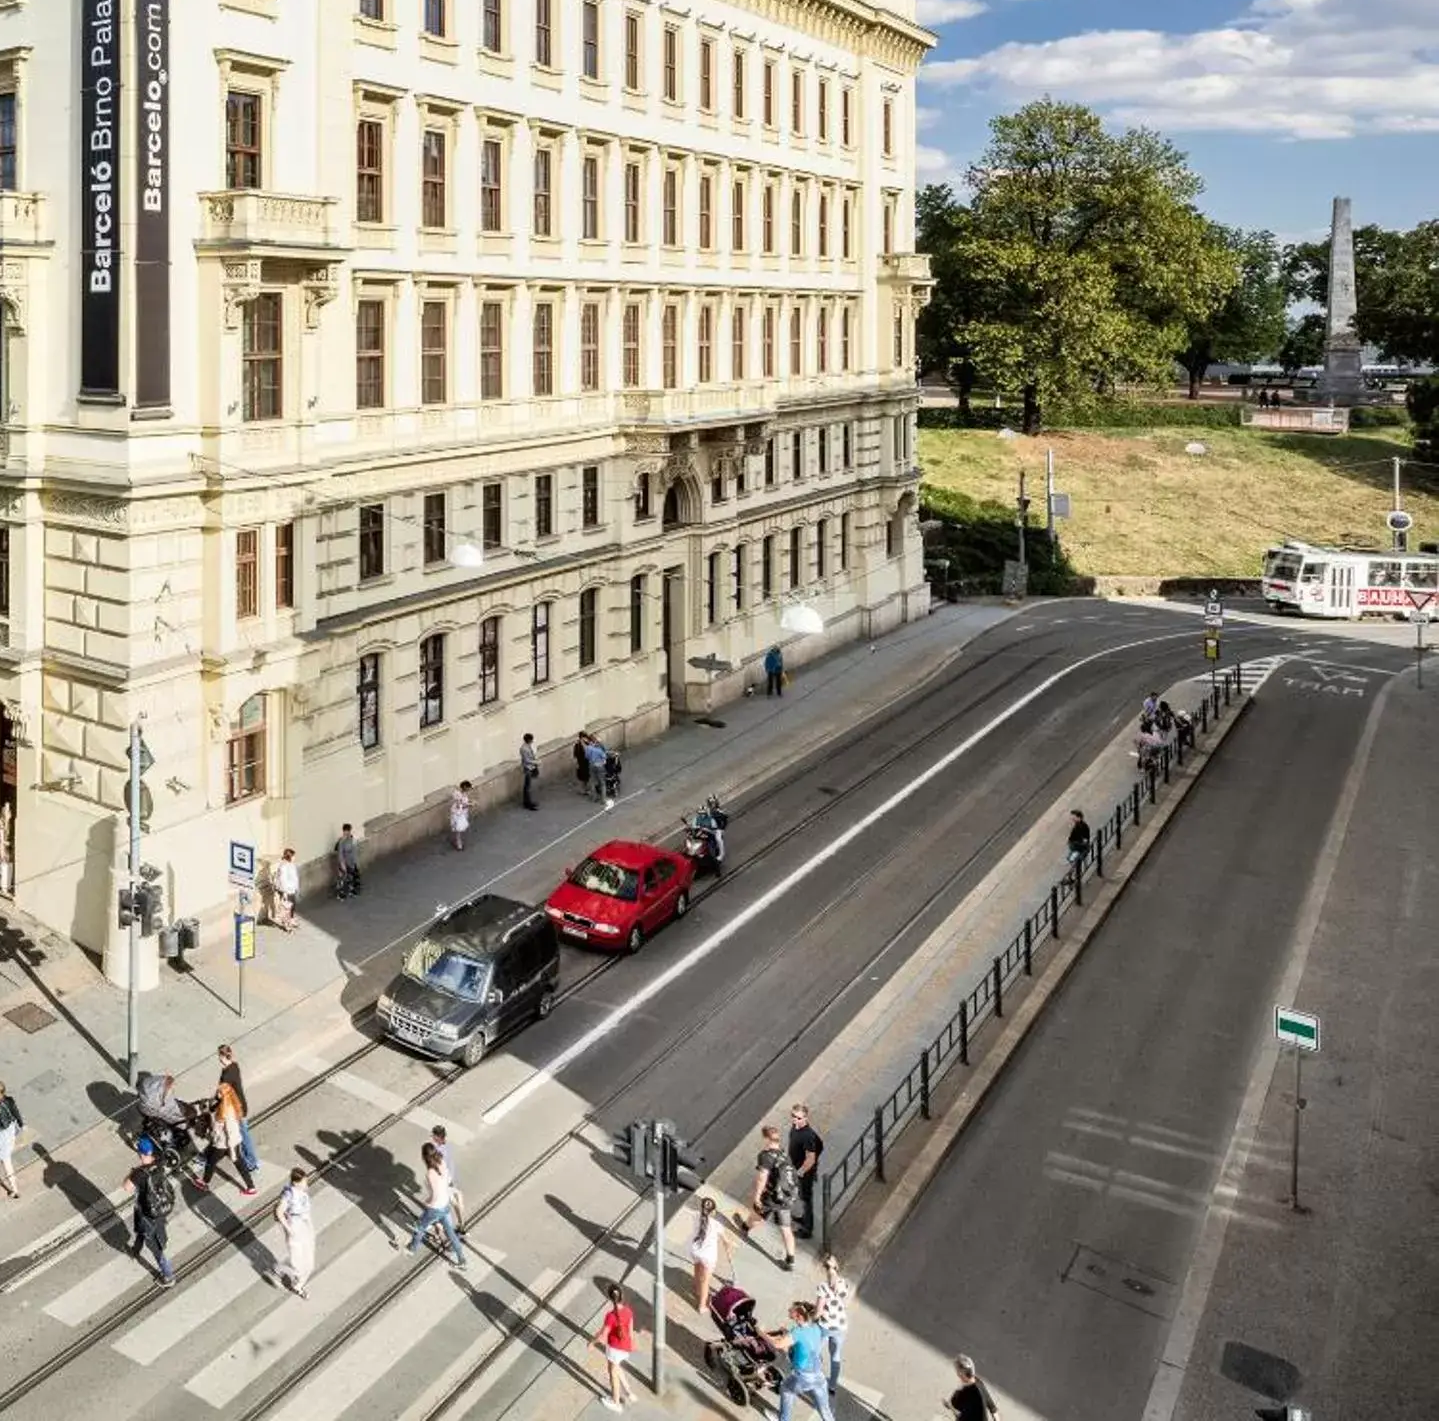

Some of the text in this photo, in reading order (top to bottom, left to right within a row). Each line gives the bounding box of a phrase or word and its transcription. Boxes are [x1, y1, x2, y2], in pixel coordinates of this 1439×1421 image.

[91, 76, 112, 151] Brno
[90, 160, 112, 293] Barceló
[1357, 589, 1439, 606] BAUHA
